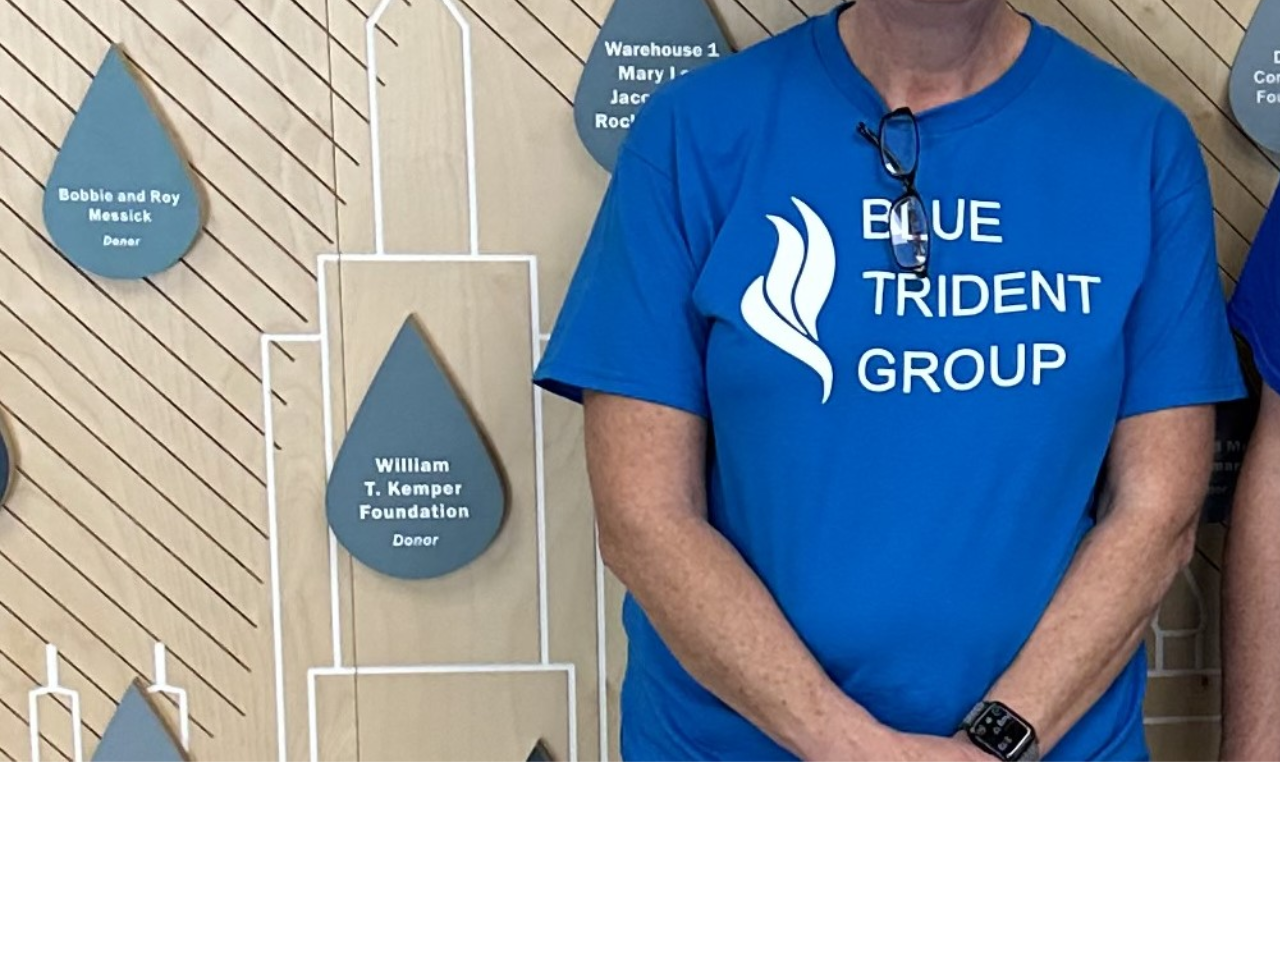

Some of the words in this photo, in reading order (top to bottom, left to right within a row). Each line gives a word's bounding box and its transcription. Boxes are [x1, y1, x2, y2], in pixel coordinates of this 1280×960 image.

[604, 41, 703, 58] Warehouse
[707, 42, 720, 58] 1
[618, 65, 665, 85] Mary
[58, 188, 114, 202] Bobbie
[117, 189, 146, 202] and
[150, 189, 181, 207] Roy
[88, 208, 153, 223] Messick
[862, 198, 1003, 243] BLUE
[102, 234, 142, 247] Donor
[862, 270, 1102, 318] TRIDENT
[857, 342, 1067, 394] GROUP
[375, 457, 450, 473] William
[363, 481, 381, 496] T.
[387, 481, 462, 499] Kemper
[359, 503, 470, 520] Foundation
[392, 533, 439, 547] Donor
